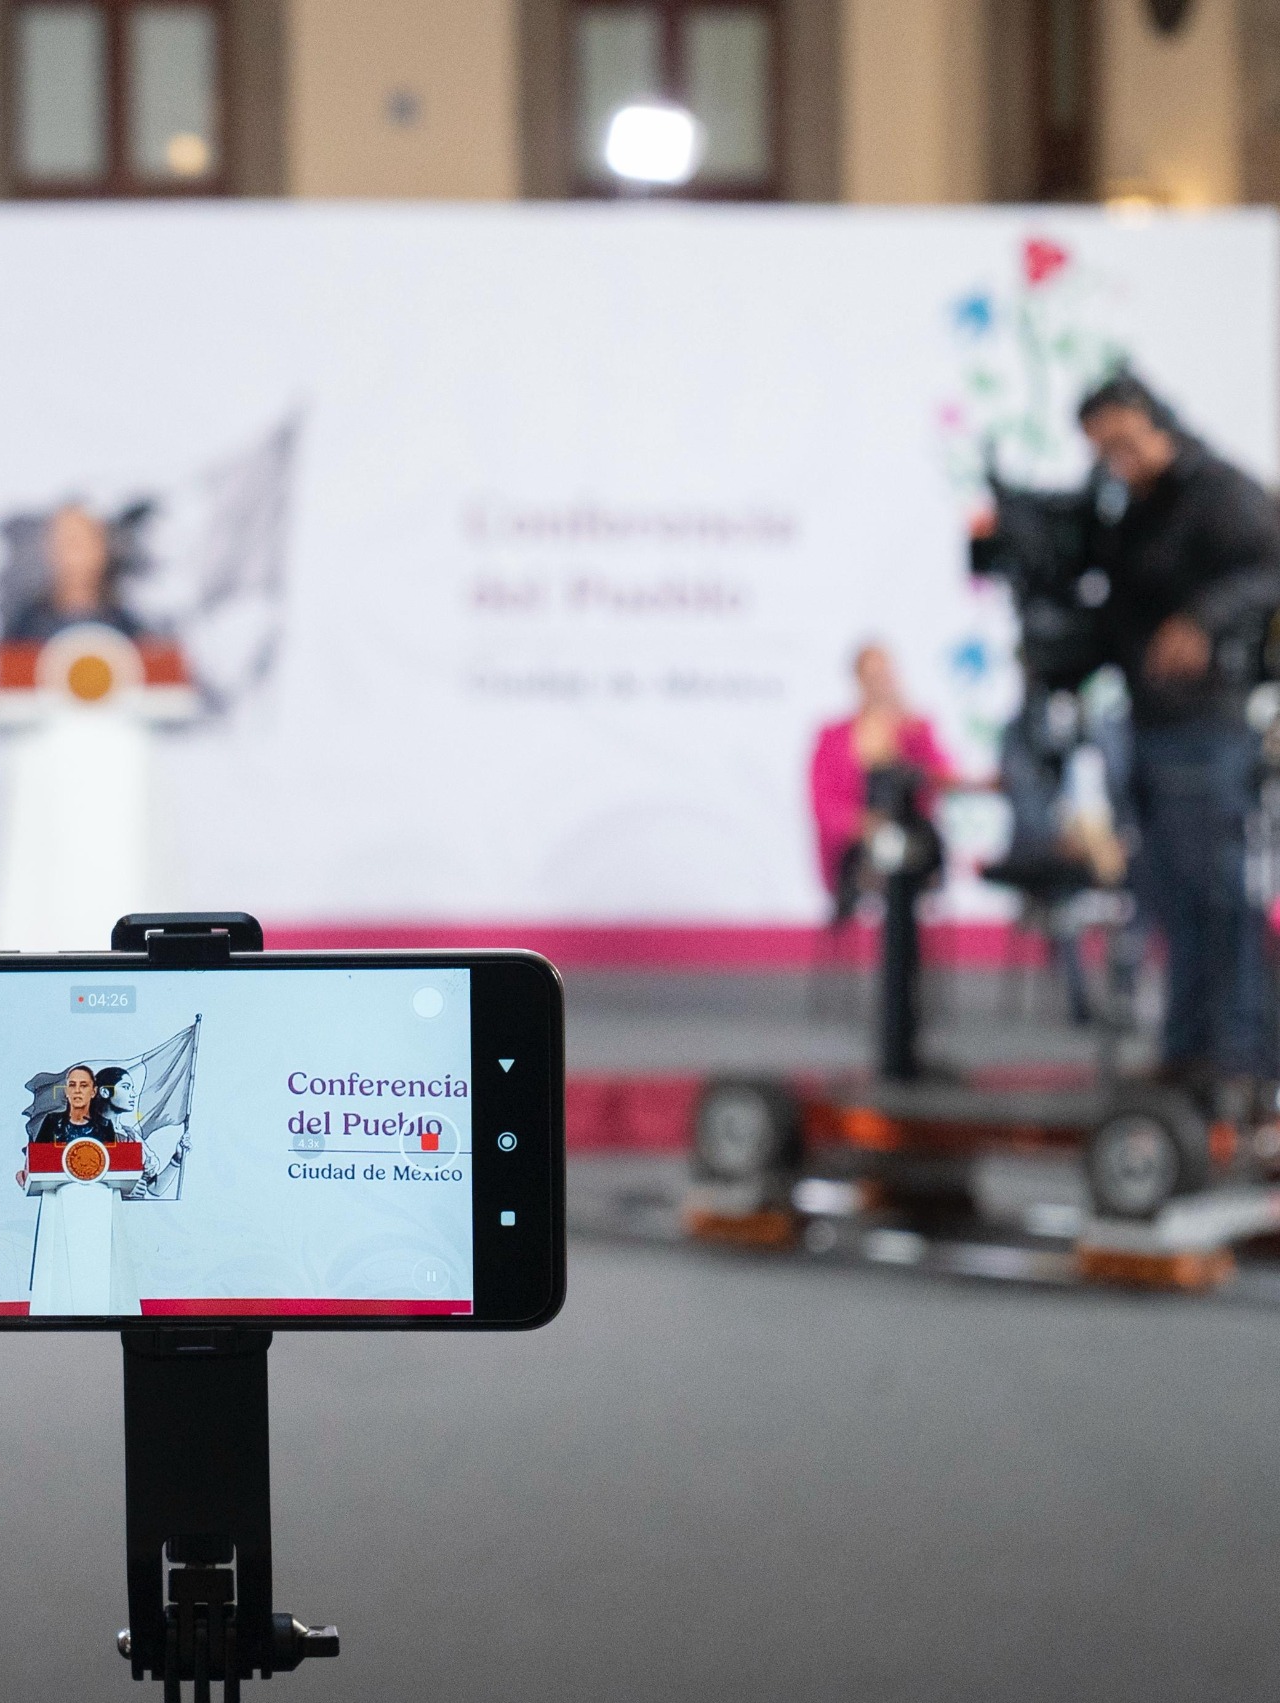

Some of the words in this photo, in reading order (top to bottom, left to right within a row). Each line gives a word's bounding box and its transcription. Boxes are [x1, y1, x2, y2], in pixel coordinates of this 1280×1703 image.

[88, 993, 128, 1007] 04:26
[287, 1071, 468, 1098] Conferencia
[287, 1110, 331, 1135] del
[342, 1112, 443, 1137] Pueblo
[298, 1138, 320, 1149] 4.3x
[287, 1163, 356, 1180] Ciudad
[363, 1164, 386, 1180] de
